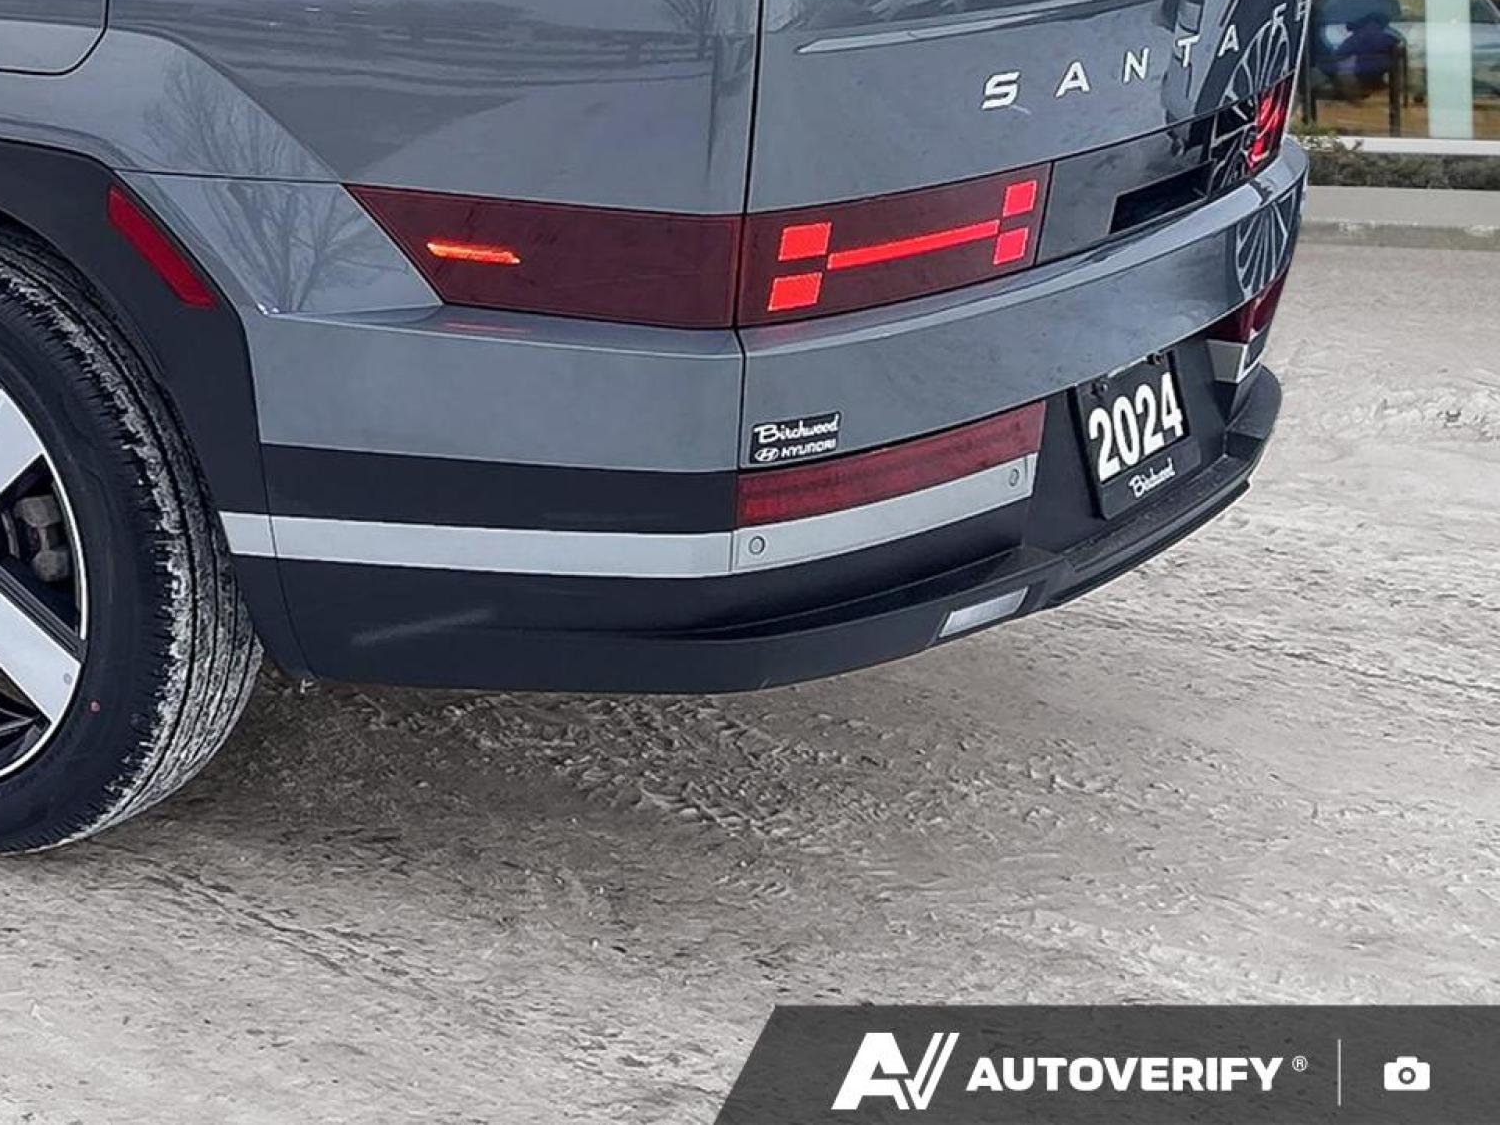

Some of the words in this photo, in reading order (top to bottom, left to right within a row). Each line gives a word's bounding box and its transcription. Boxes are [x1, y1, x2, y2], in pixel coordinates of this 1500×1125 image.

[981, 24, 1241, 111] SANTA
[753, 413, 840, 444] Birchwood
[781, 438, 837, 458] HYUNDAI
[1088, 371, 1185, 482] 2024
